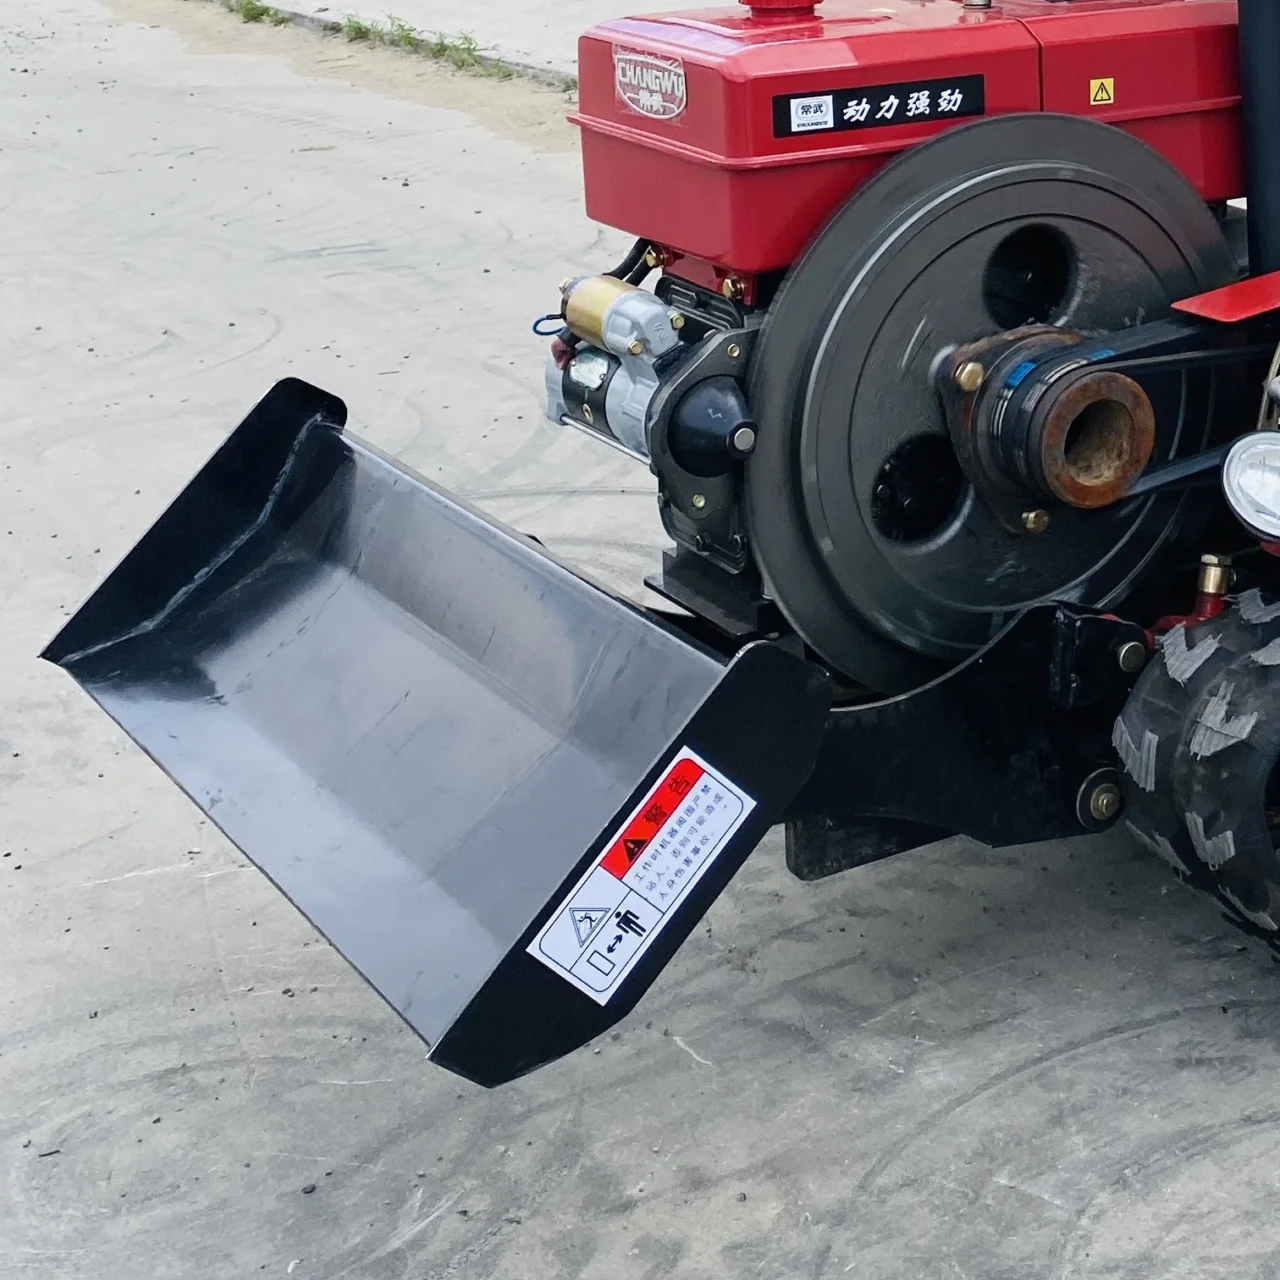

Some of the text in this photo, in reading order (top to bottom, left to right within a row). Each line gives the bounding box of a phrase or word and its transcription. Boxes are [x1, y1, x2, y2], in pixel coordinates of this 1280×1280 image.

[617, 61, 685, 98] CHANGWU
[842, 88, 964, 122] 动力强劲
[643, 775, 690, 826] 警告
